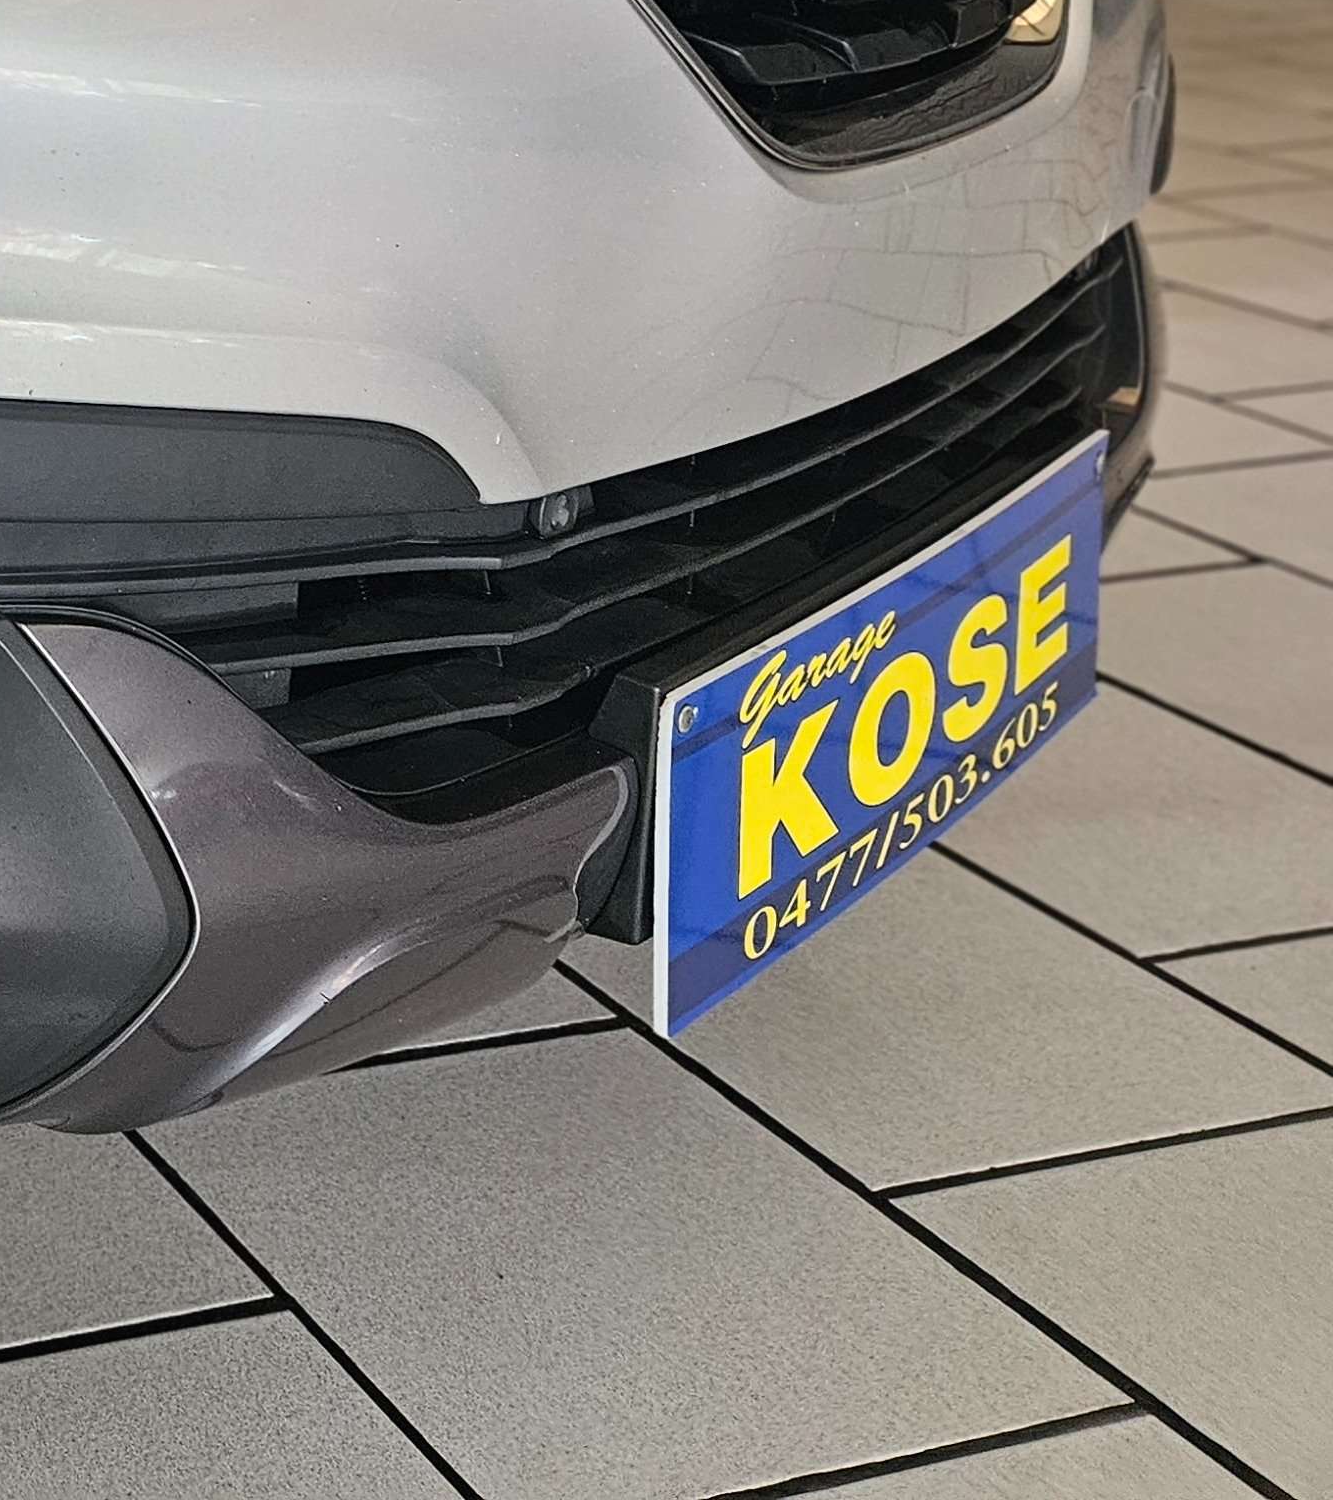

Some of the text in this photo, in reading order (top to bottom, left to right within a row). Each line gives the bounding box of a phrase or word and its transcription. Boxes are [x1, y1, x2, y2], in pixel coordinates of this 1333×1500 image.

[738, 609, 896, 748] Garage
[738, 534, 1072, 900] KOSE
[743, 681, 1059, 960] 0477/503.605
